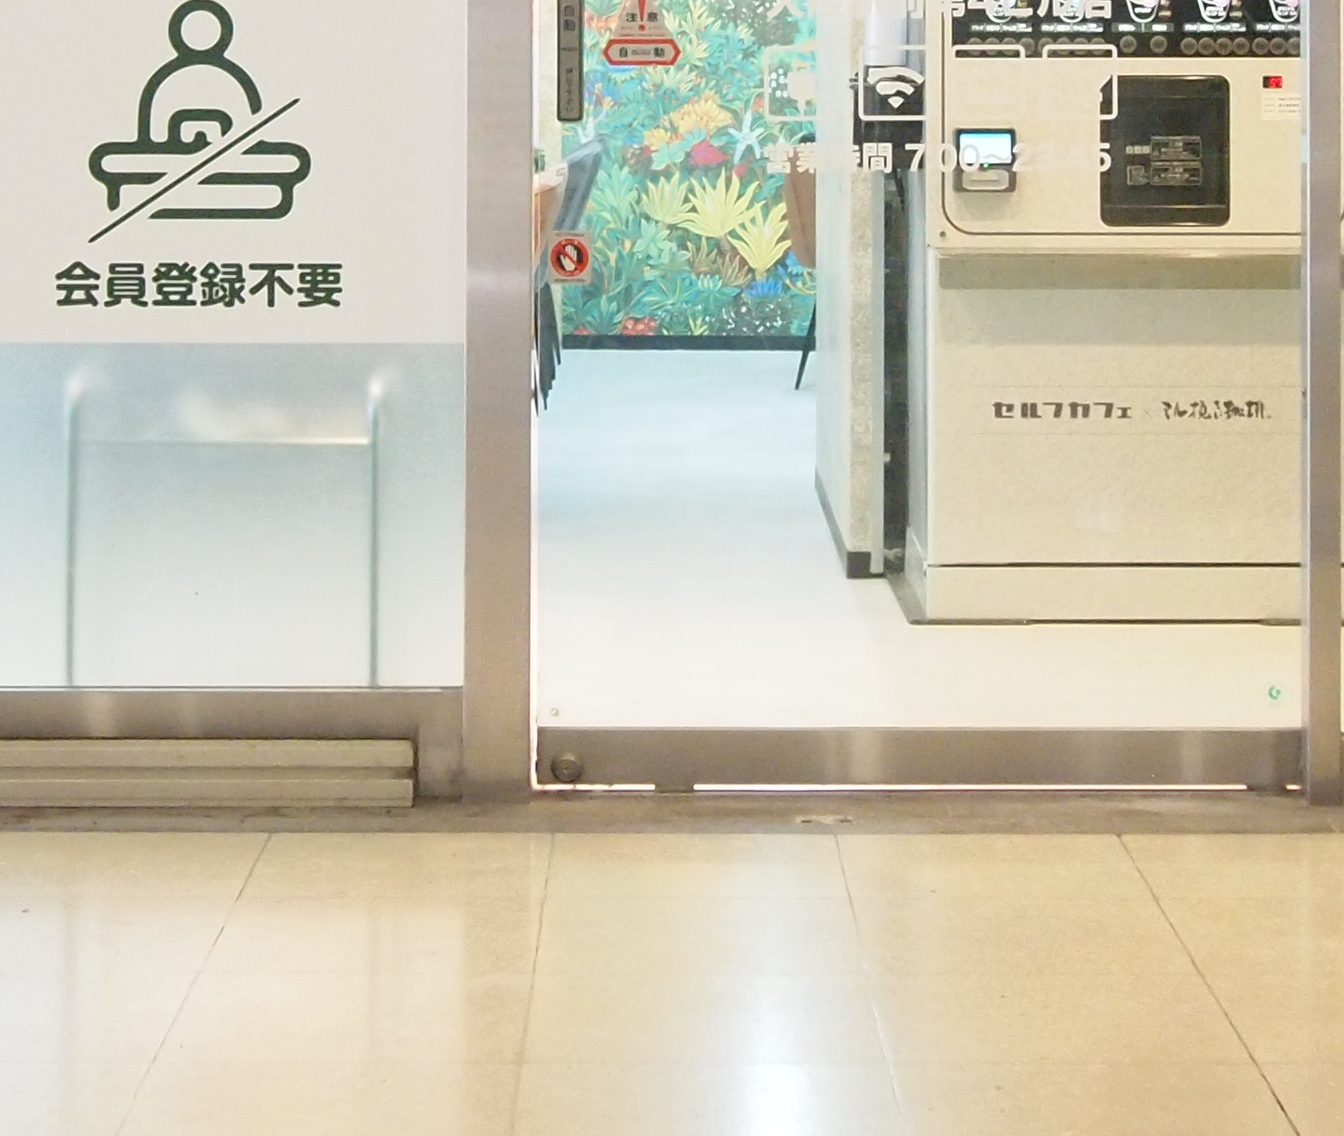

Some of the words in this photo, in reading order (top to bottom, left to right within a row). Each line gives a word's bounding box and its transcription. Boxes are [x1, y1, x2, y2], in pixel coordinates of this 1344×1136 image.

[55, 261, 343, 308] 会員登録不要
[992, 401, 1132, 419] セルフカフェ
